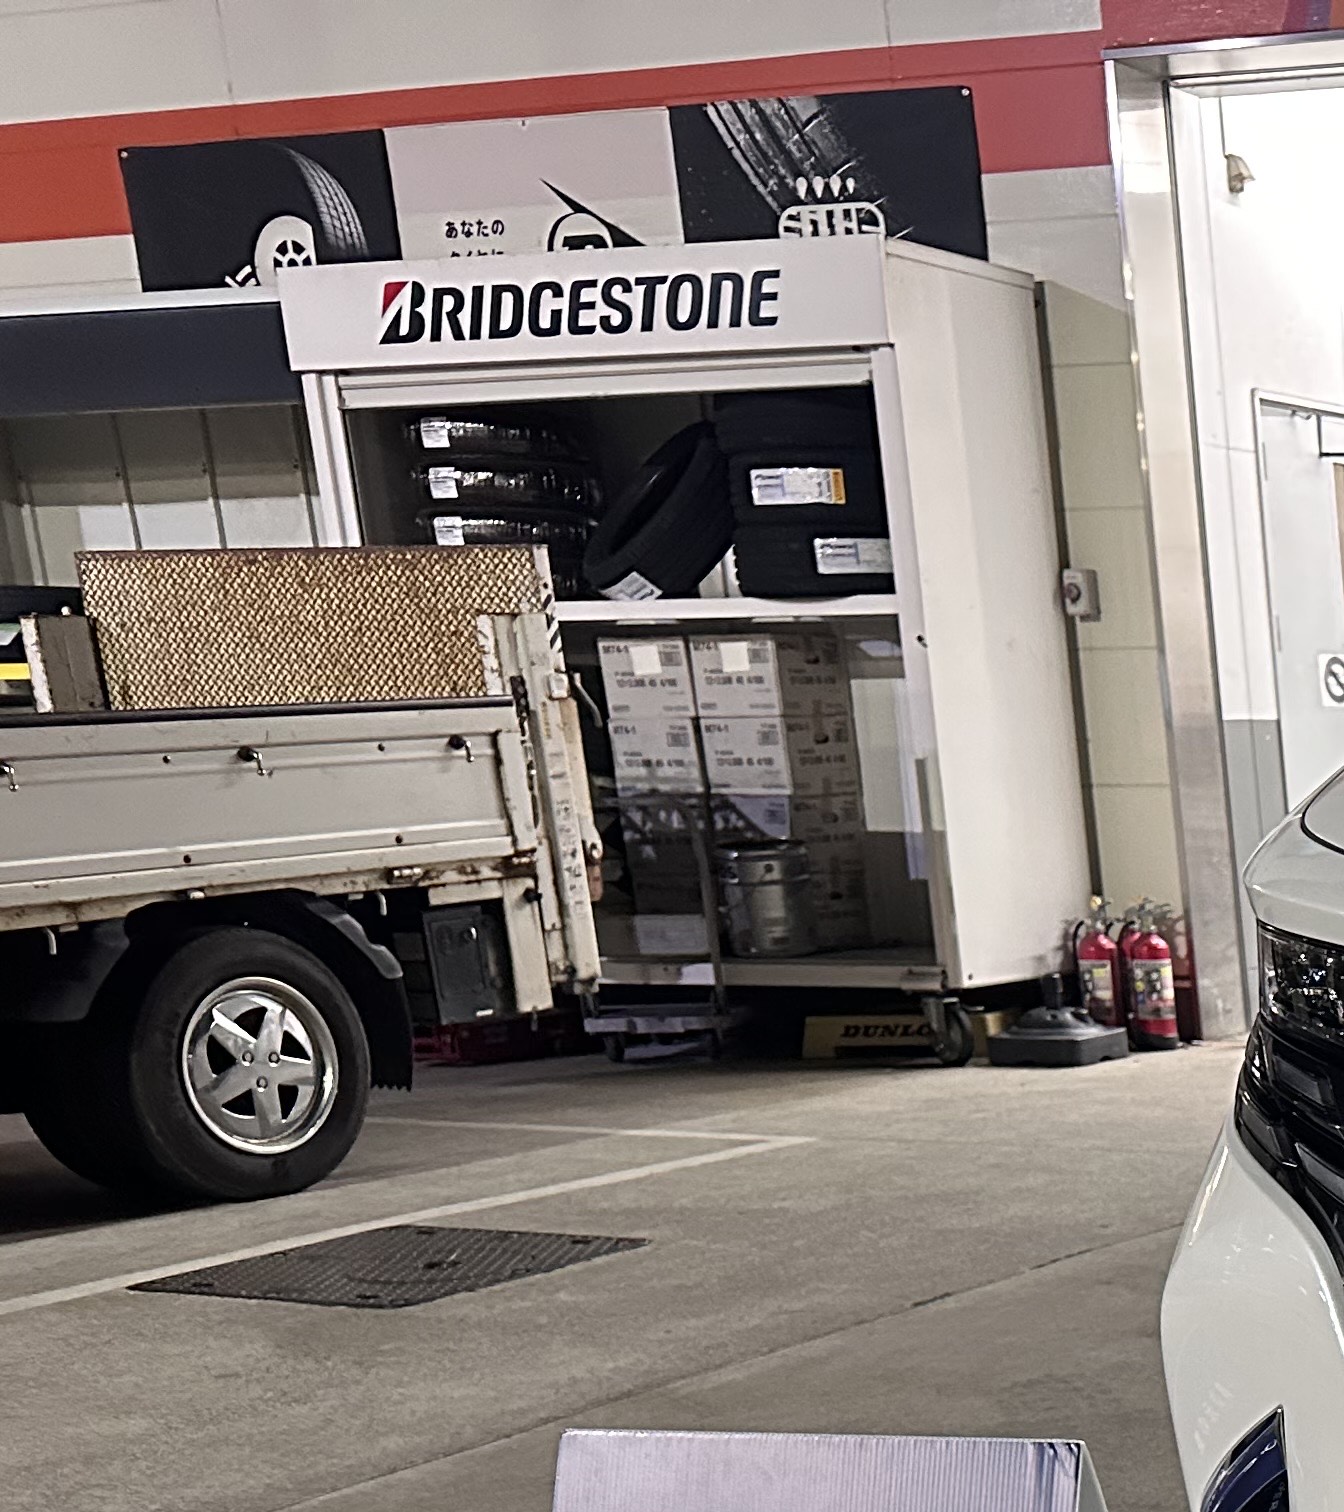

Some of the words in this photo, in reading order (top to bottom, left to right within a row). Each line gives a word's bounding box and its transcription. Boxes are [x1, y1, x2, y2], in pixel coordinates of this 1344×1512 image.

[445, 219, 505, 238] あなたの
[379, 269, 781, 345] BRIDGESTONE
[841, 1023, 934, 1038] DUNLO
